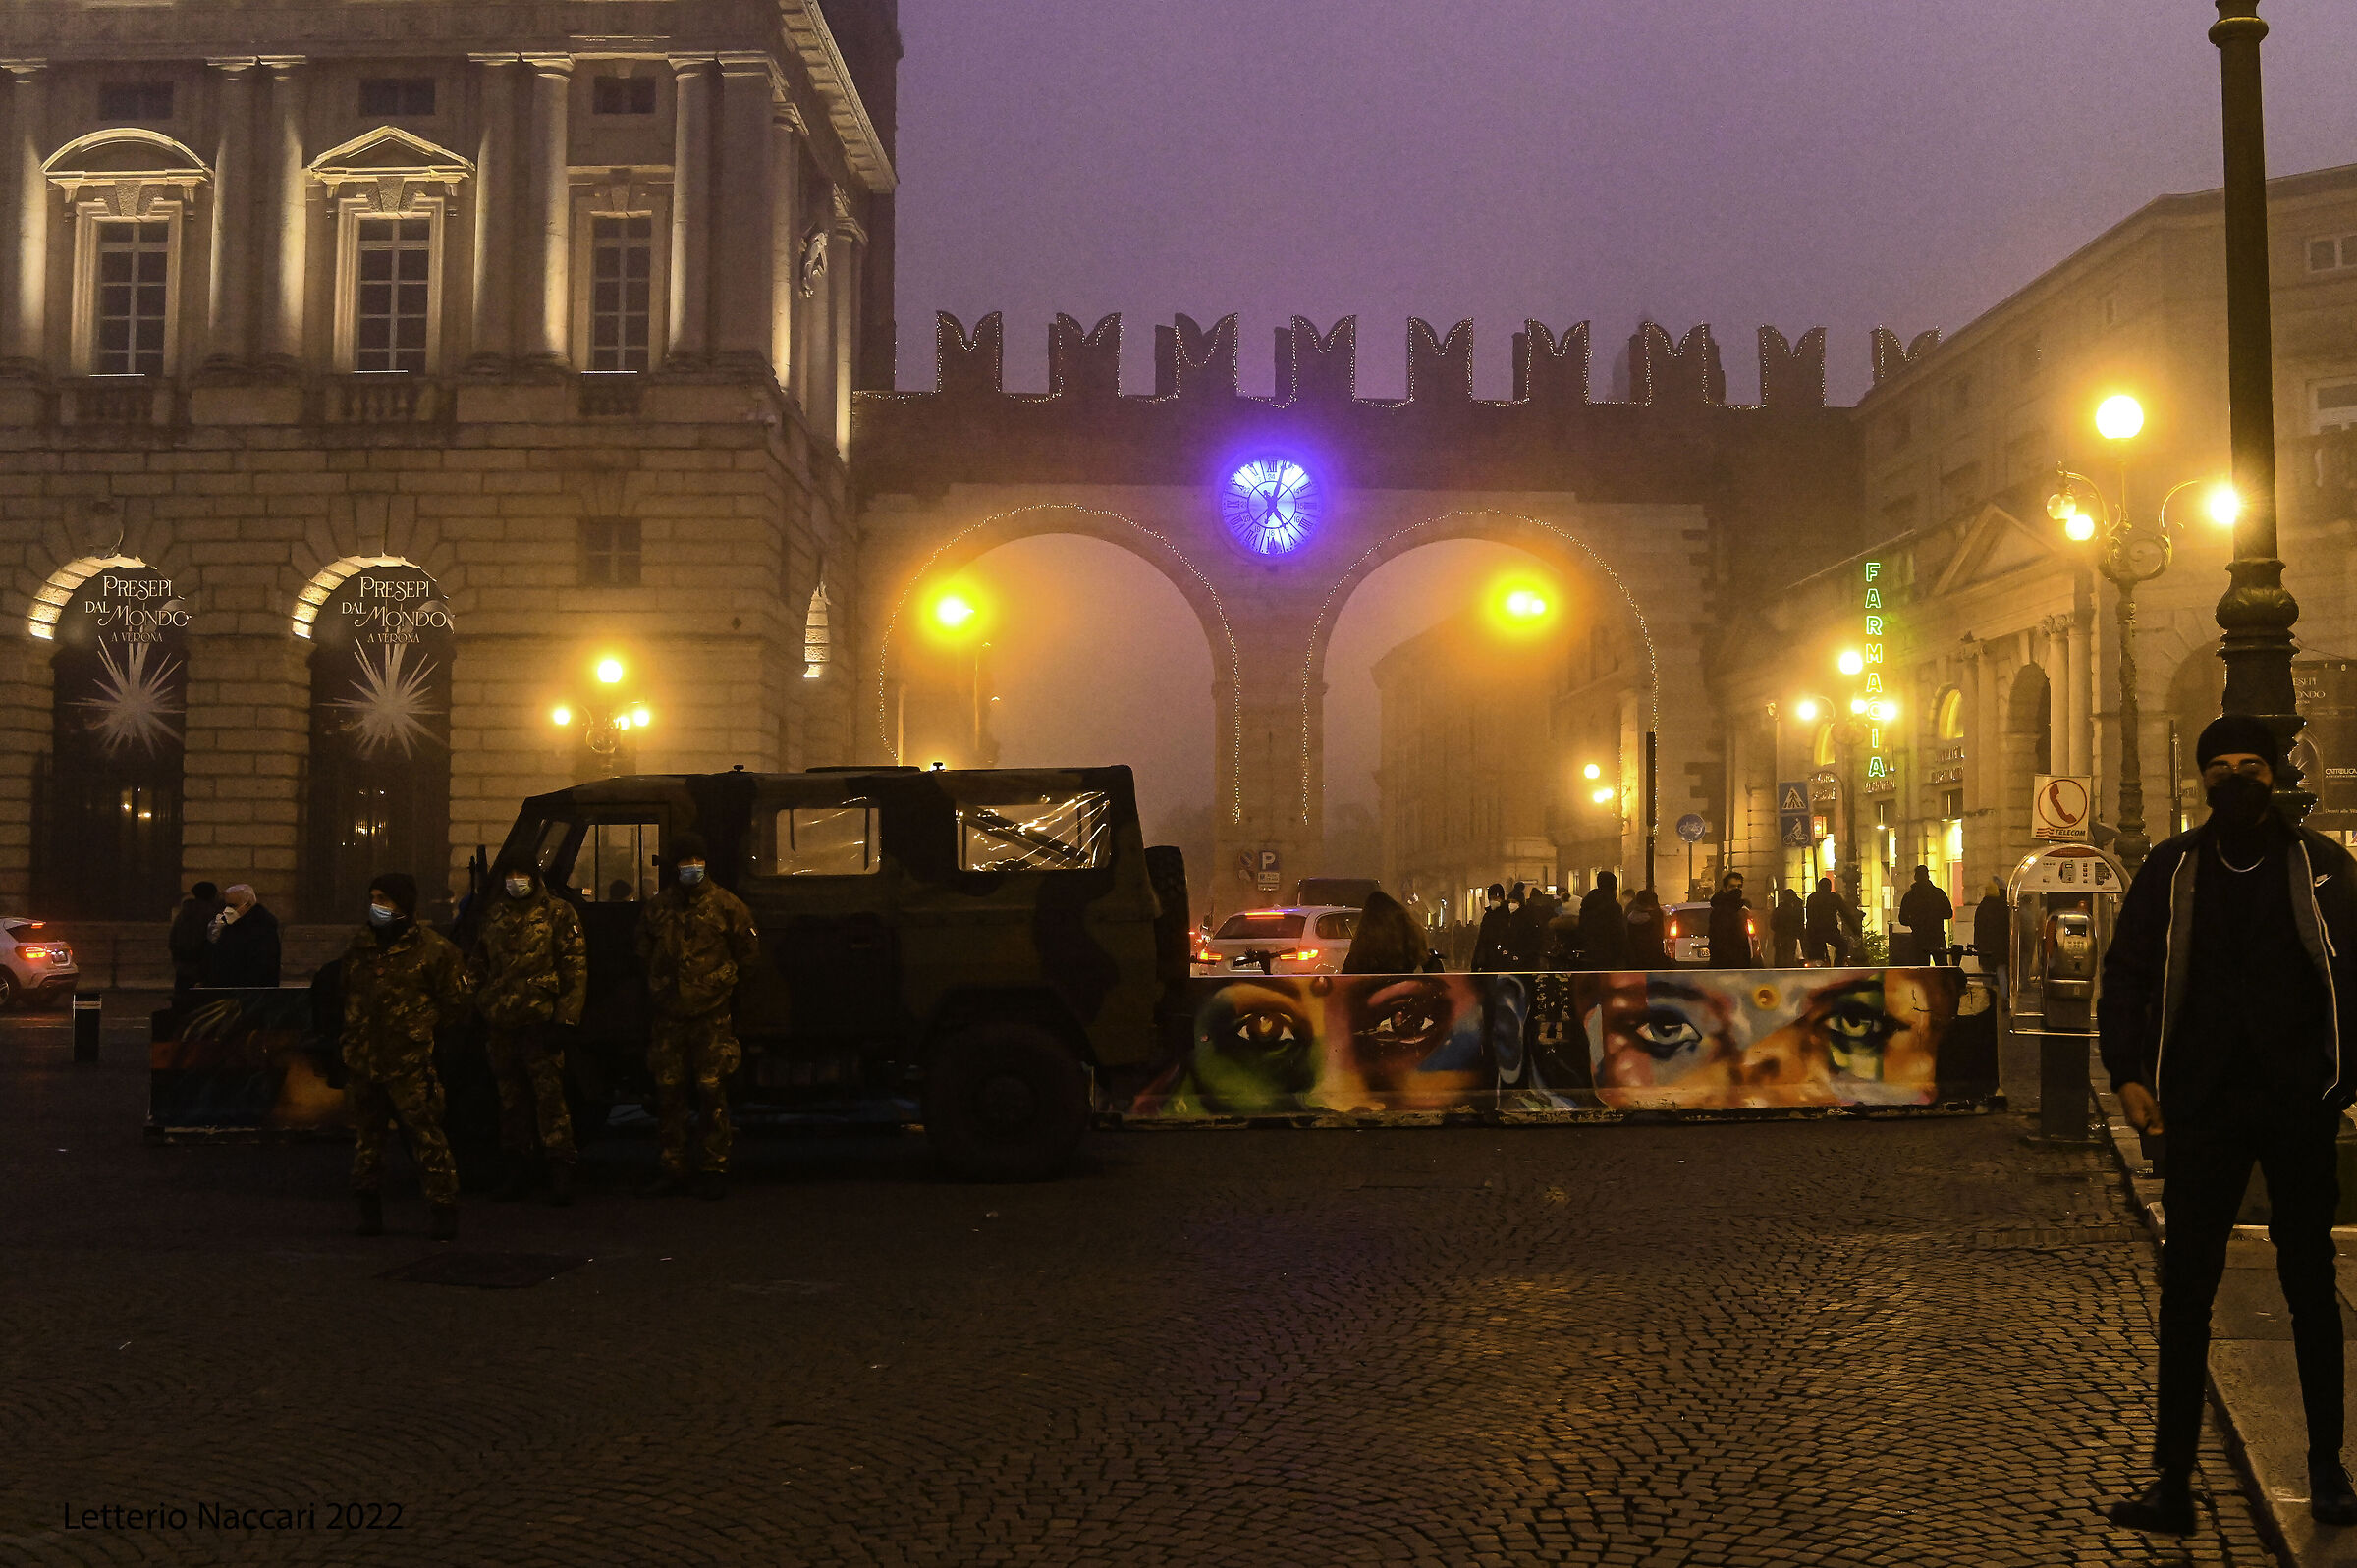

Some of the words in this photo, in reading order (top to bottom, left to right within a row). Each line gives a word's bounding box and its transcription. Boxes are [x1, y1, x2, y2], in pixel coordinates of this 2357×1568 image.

[103, 575, 173, 601] PRESEPI
[359, 576, 430, 602] PRESEPI
[85, 601, 111, 614] DAL
[97, 605, 189, 627] MONDO
[341, 601, 367, 615] DAL
[354, 605, 447, 628] MONDO
[111, 631, 118, 643] A
[121, 631, 164, 643] VERONA
[367, 633, 374, 644] A
[377, 633, 420, 644] VERONA
[1865, 562, 1886, 778] FARMACIA
[2055, 828, 2086, 837] TELECOM
[1262, 851, 1276, 870] P
